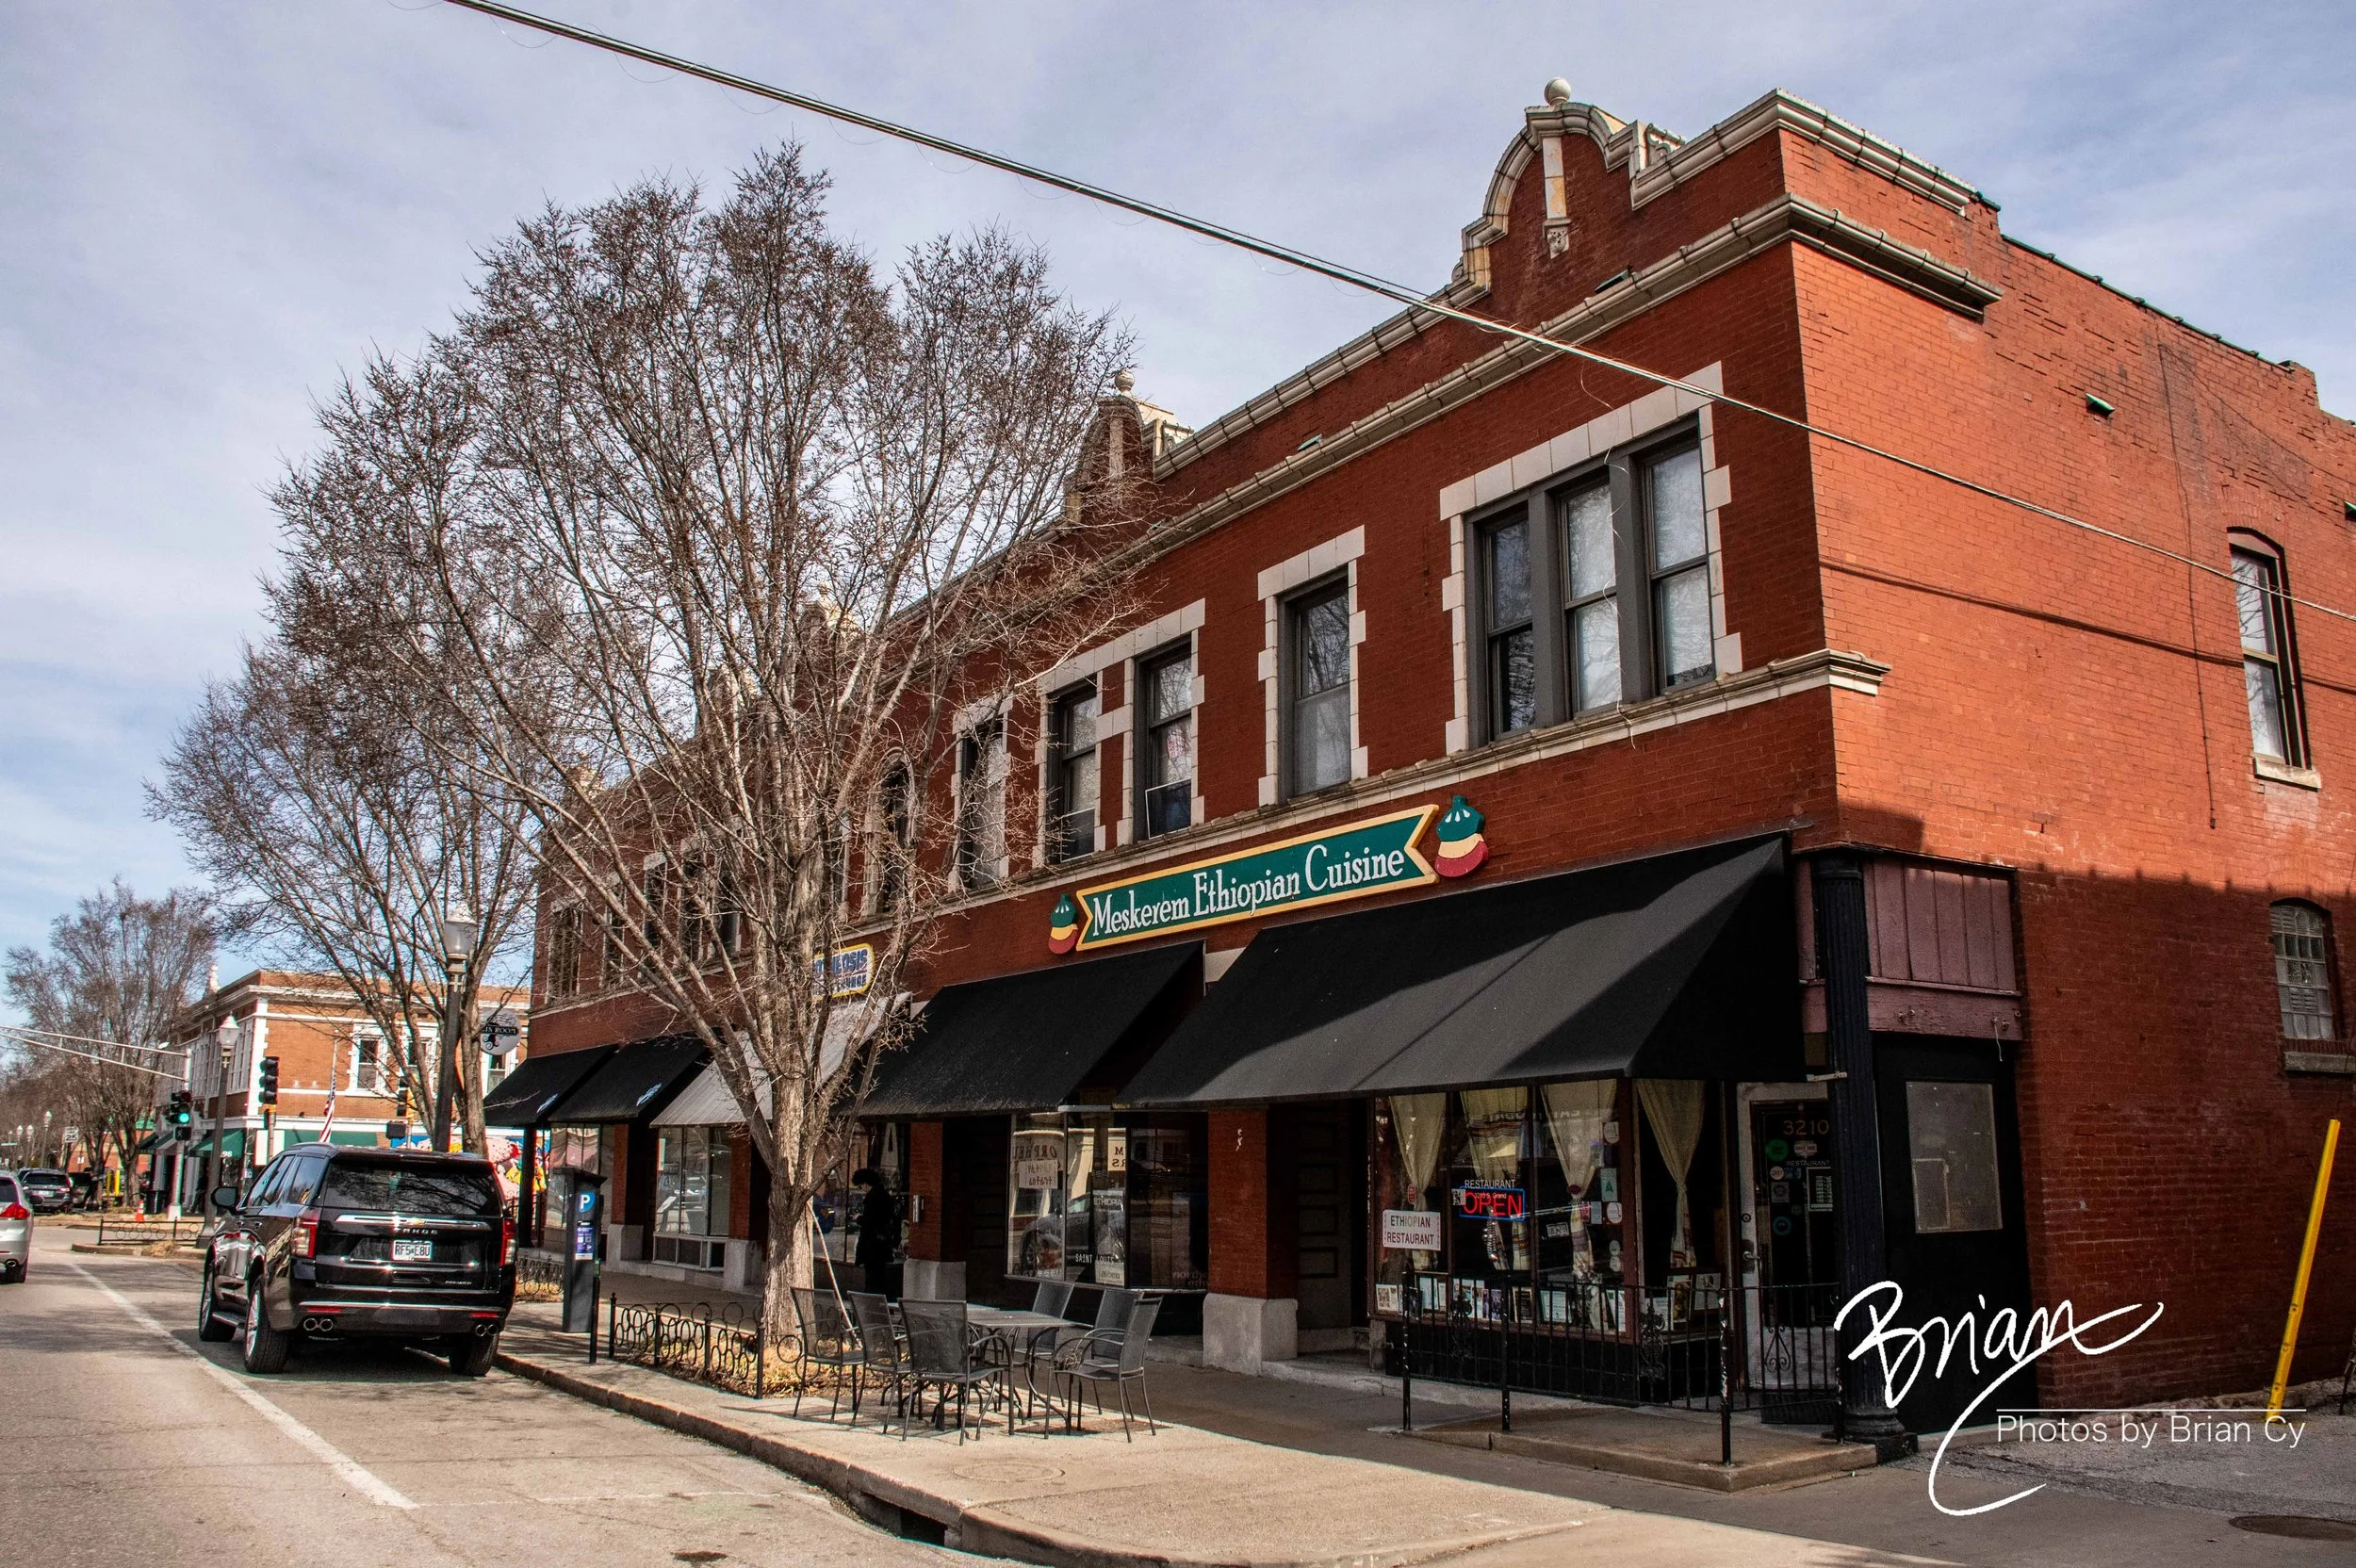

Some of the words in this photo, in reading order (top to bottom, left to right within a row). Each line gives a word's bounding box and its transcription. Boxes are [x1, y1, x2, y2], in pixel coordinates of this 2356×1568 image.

[1093, 890, 1190, 937] Meskerem
[1193, 869, 1301, 916] Ethiopian
[1305, 844, 1405, 891] Cuisine
[1782, 1119, 1830, 1135] 3210
[1464, 1179, 1516, 1189] RESTAURANT
[580, 1194, 591, 1210] P
[1463, 1190, 1522, 1217] OPEN
[1390, 1215, 1431, 1228] ETHIOPIAN
[1386, 1232, 1434, 1245] RESTAURANT
[1074, 1253, 1093, 1264] SAINT
